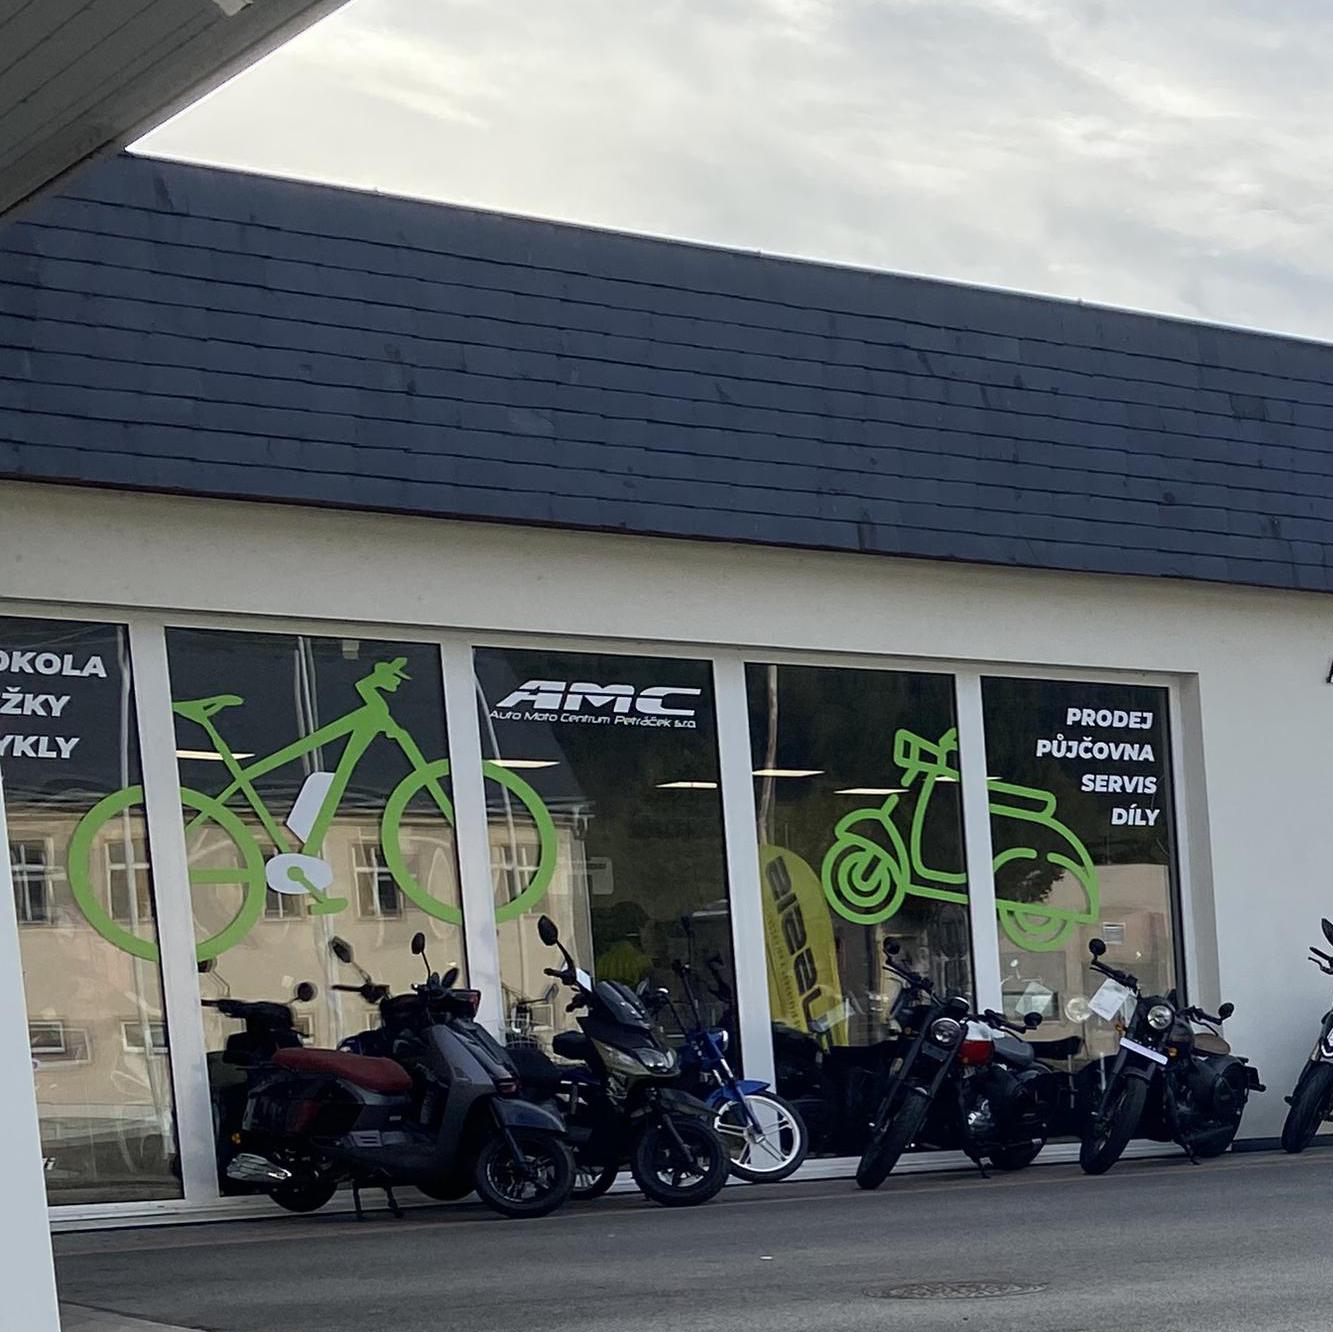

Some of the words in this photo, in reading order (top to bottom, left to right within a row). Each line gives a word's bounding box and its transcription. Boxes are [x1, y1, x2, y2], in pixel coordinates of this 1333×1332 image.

[496, 679, 701, 716] AMC
[487, 710, 521, 720] Auto
[523, 712, 558, 722] Moto
[560, 713, 610, 724] Centrum
[1066, 708, 1153, 729] PRODEJ
[1036, 733, 1155, 762] PŮJČOVNA
[1081, 774, 1157, 794] SERVIS
[1111, 803, 1160, 826] DÍLY
